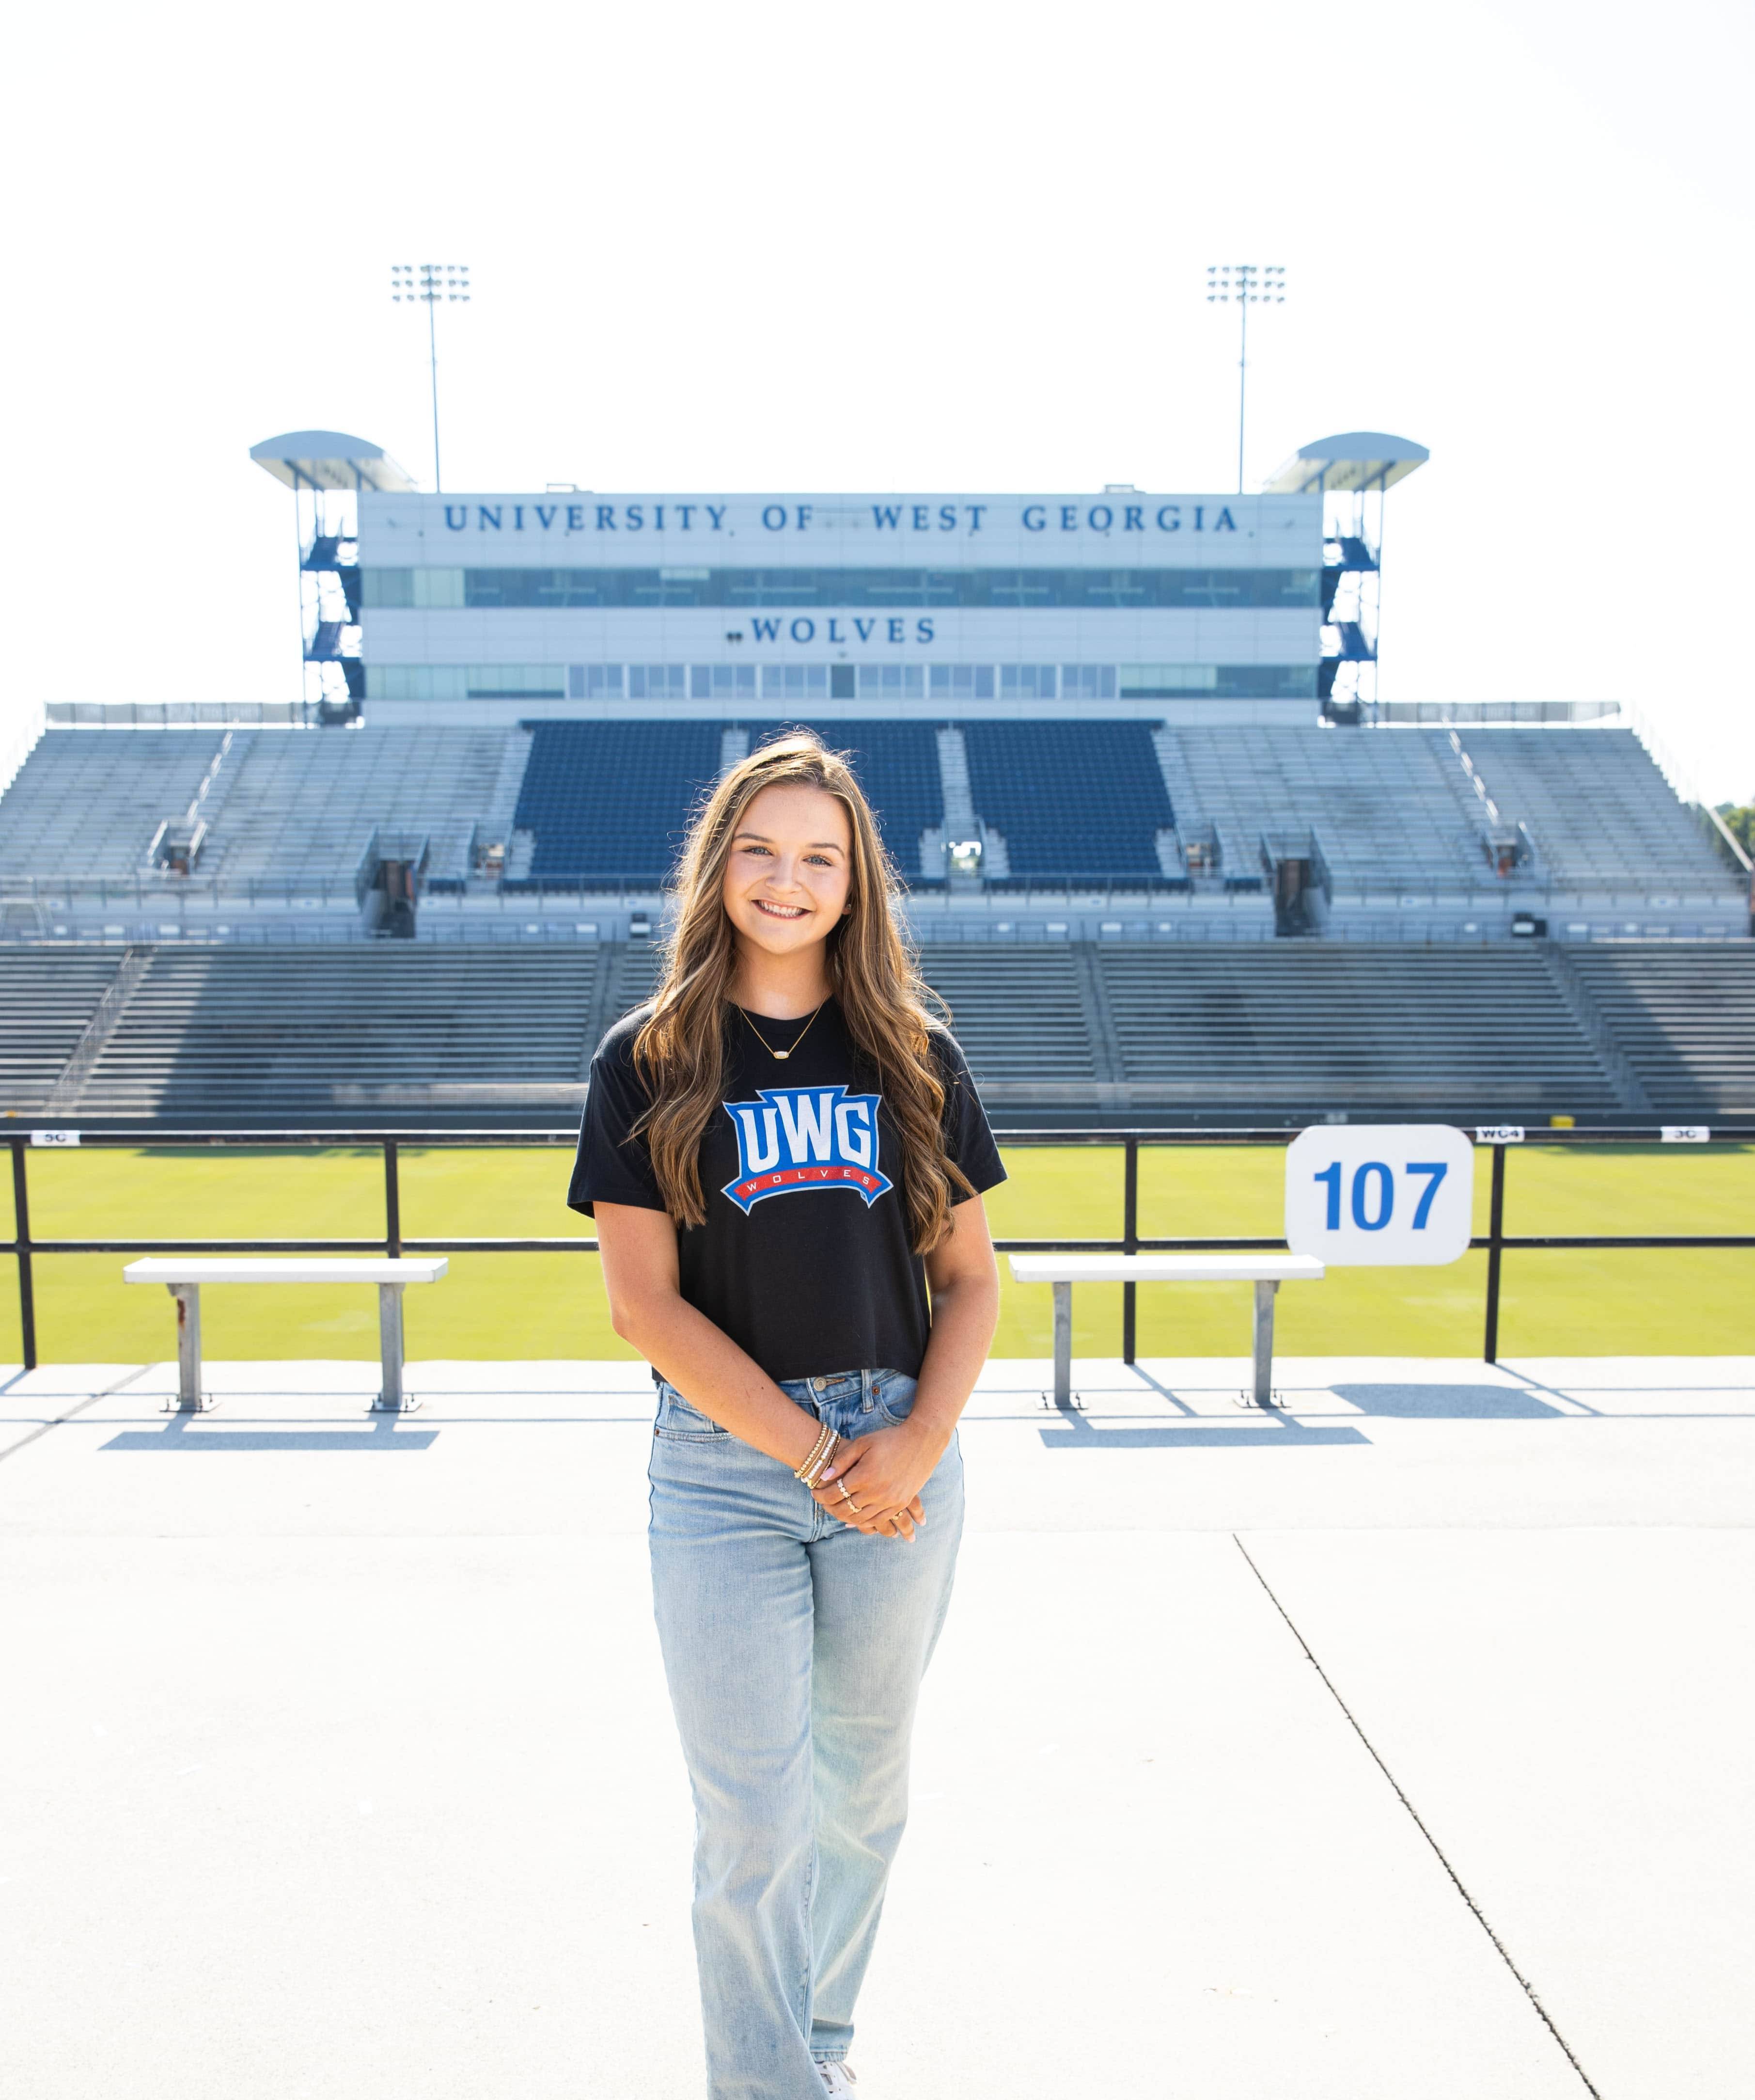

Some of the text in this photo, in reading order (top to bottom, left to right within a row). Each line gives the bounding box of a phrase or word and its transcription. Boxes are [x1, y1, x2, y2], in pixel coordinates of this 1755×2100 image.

[443, 504, 1238, 533] UNIVERSITY OF WEST GEORGIA
[751, 617, 935, 644] WOLVES
[736, 1092, 872, 1174] UWG
[746, 1168, 871, 1193] WOLVES
[1314, 1161, 1448, 1232] 107
